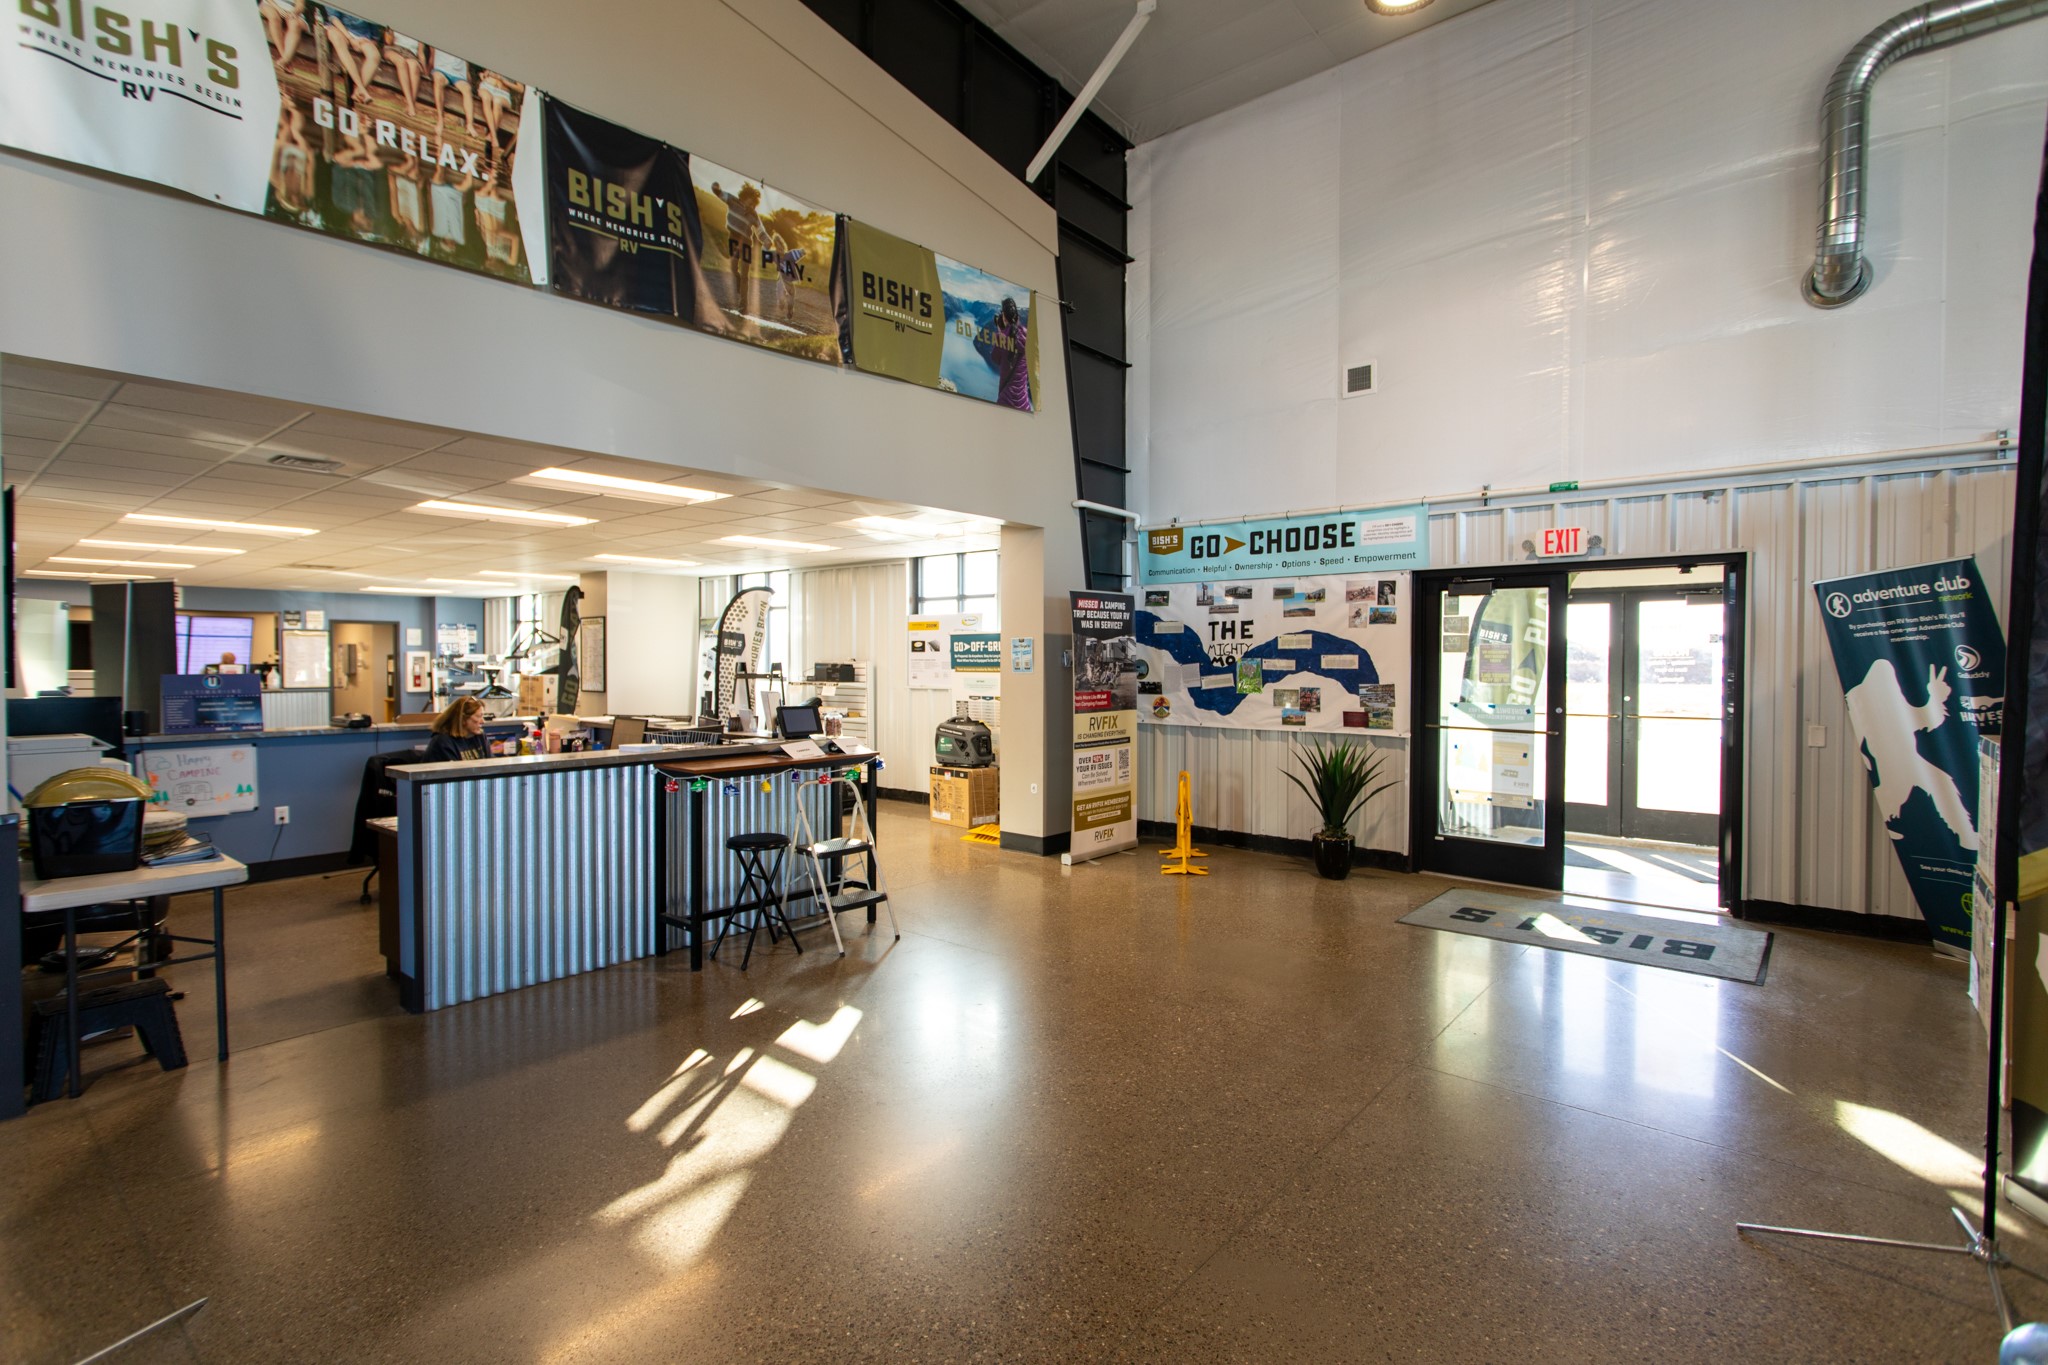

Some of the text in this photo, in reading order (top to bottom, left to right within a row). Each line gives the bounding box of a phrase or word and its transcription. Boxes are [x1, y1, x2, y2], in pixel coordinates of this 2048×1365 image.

[19, 25, 242, 108] WHERE MEMORIES BEGIN
[121, 80, 155, 102] RV
[313, 97, 490, 182] GO RELAX.
[568, 167, 682, 237] BISH'S
[568, 208, 684, 250] WHERE MEMORIES BEGIN
[620, 239, 638, 255] RV
[729, 239, 752, 264] GO
[863, 271, 932, 318] BISH'S
[863, 302, 883, 313] WHERE
[915, 319, 933, 328] BEGIN
[895, 321, 906, 333] RV
[956, 319, 1018, 353] GO LEARN.
[1152, 535, 1178, 545] BISH'S
[1191, 535, 1221, 559] GO
[1250, 522, 1356, 555] CHOOSE
[1544, 528, 1580, 554] EXIT
[1148, 551, 1416, 577] Communication Helpful Ownership Options Speed Empowerment
[1853, 575, 1971, 604] adventure club
[1078, 600, 1126, 610] MISSED A CAMPING
[1073, 610, 1130, 620] TRIP BECAUSE YOUR RV
[1857, 621, 1886, 629] purchasing
[1950, 612, 1966, 620] you'll
[1081, 620, 1123, 629] WAS IN SERVICE?
[1208, 620, 1254, 641] THE
[1918, 623, 1951, 632] Adventure
[1480, 629, 1508, 642] BISH'S
[1890, 635, 1930, 643] membership.
[953, 641, 963, 652] GO
[1208, 643, 1253, 657] MIGHTY
[1211, 655, 1236, 667] MO
[560, 681, 580, 706] GO
[1089, 715, 1118, 731] RVFIX
[1083, 731, 1103, 739] CHANGING
[1076, 765, 1089, 773] YOUR
[1097, 762, 1112, 770] ISSUES
[1095, 828, 1114, 841] RVFIX
